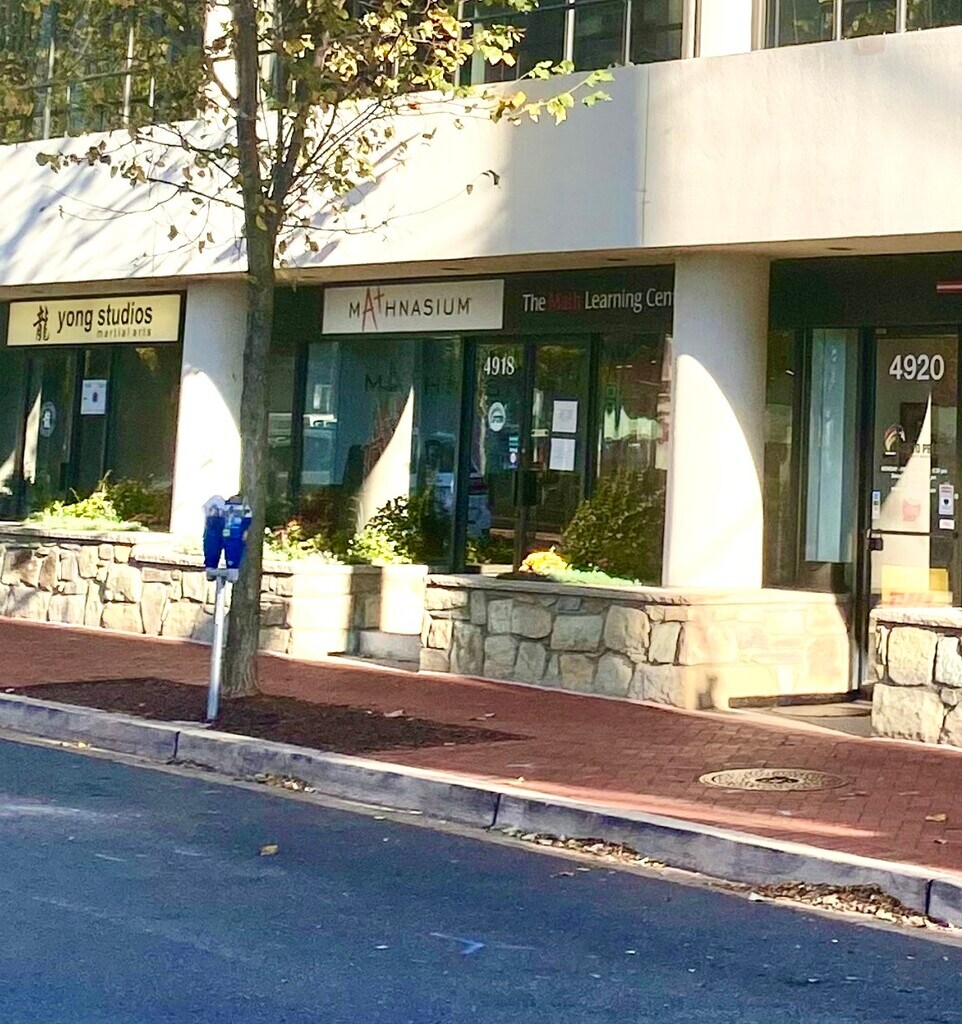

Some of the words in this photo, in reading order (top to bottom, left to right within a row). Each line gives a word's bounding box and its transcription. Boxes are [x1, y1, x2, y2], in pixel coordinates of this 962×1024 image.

[348, 286, 470, 332] MATHNASIUM
[523, 294, 546, 312] The
[584, 289, 643, 314] Learning
[646, 288, 674, 307] Cen
[57, 309, 93, 334] yong
[97, 302, 153, 326] studios
[96, 328, 130, 338] martial
[132, 327, 152, 337] arts
[484, 356, 515, 375] 4918
[889, 354, 945, 380] 4920
